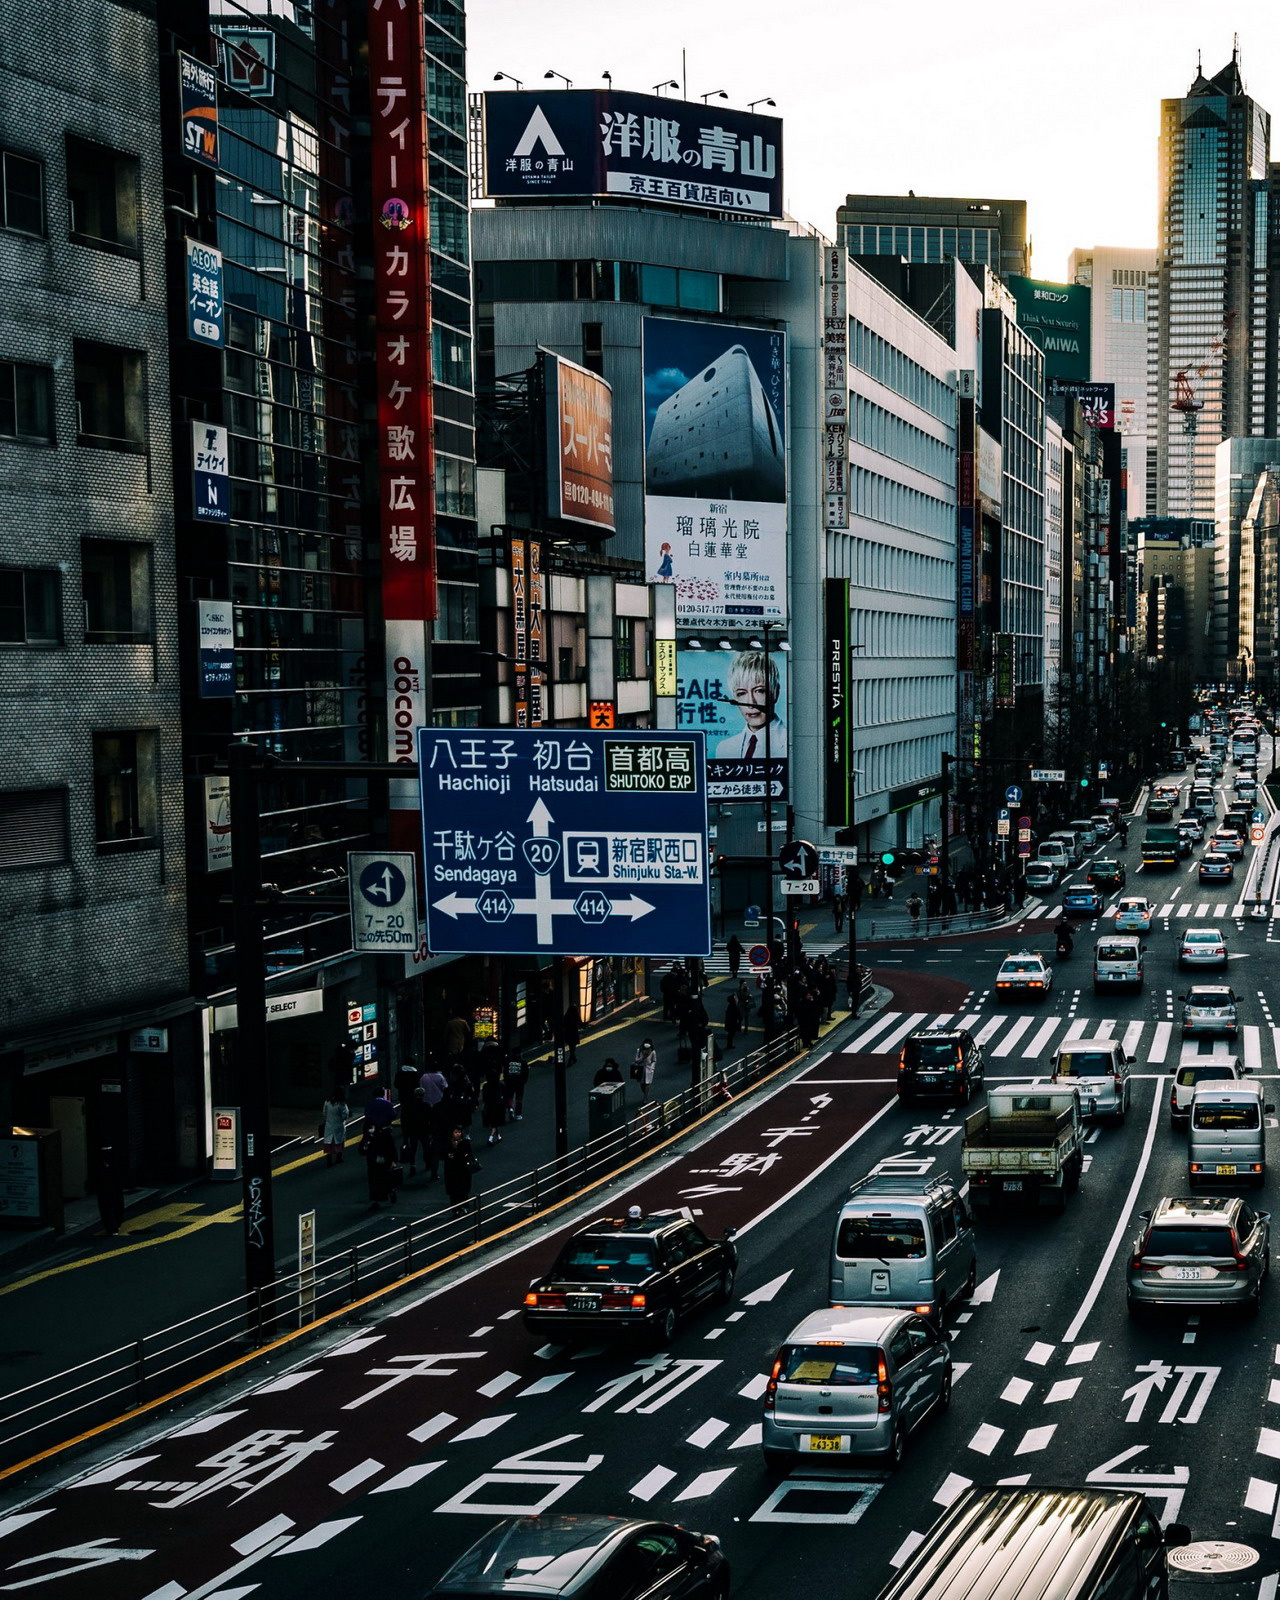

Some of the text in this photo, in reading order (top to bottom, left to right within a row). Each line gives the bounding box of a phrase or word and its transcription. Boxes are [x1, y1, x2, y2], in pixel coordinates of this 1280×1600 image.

[372, 0, 411, 188] ーティー
[600, 111, 776, 180] 洋服の青山
[505, 158, 574, 172] 洋服の青山
[629, 175, 752, 207] 京王百貨店向い
[191, 247, 218, 274] AEON
[191, 273, 219, 300] 英会話
[1033, 289, 1068, 303] 美和ロック
[189, 298, 222, 318] イーオン
[825, 319, 846, 330] 共立
[1022, 313, 1040, 323] Think
[1055, 319, 1081, 330] Security
[1044, 336, 1080, 354] MIWA
[385, 245, 417, 562] カラオケ歌広場
[826, 424, 845, 433] KEN
[837, 433, 845, 458] パソコン
[197, 453, 226, 472] テイケイ
[828, 461, 836, 492] クリニック
[709, 503, 728, 514] 新宿
[676, 515, 760, 540] 瑠璃光院
[688, 540, 748, 559] 白蓮華堂
[961, 525, 973, 611] JAPAN TOTAL CLUB
[677, 605, 724, 613] 0120-517-177
[658, 642, 666, 690] エスジーマックス
[411, 677, 420, 694] NTT
[595, 713, 610, 728] 大
[430, 739, 594, 771] 八王子 初台
[609, 746, 690, 773] 首都高
[438, 774, 599, 793] Hachioji Hatsudai
[609, 774, 691, 789] SHUTOKO EXP
[1001, 810, 1008, 819] P
[530, 846, 552, 863] 20
[612, 838, 697, 863] 新宿駅西口
[434, 866, 517, 885] Sendagaya
[613, 865, 660, 881] Shinjuku
[786, 883, 814, 891] 7-20
[482, 899, 507, 914] 414
[580, 900, 606, 915] 414
[365, 915, 405, 928] 7-20
[358, 930, 413, 944] この先50m
[271, 1002, 297, 1013] SELECT
